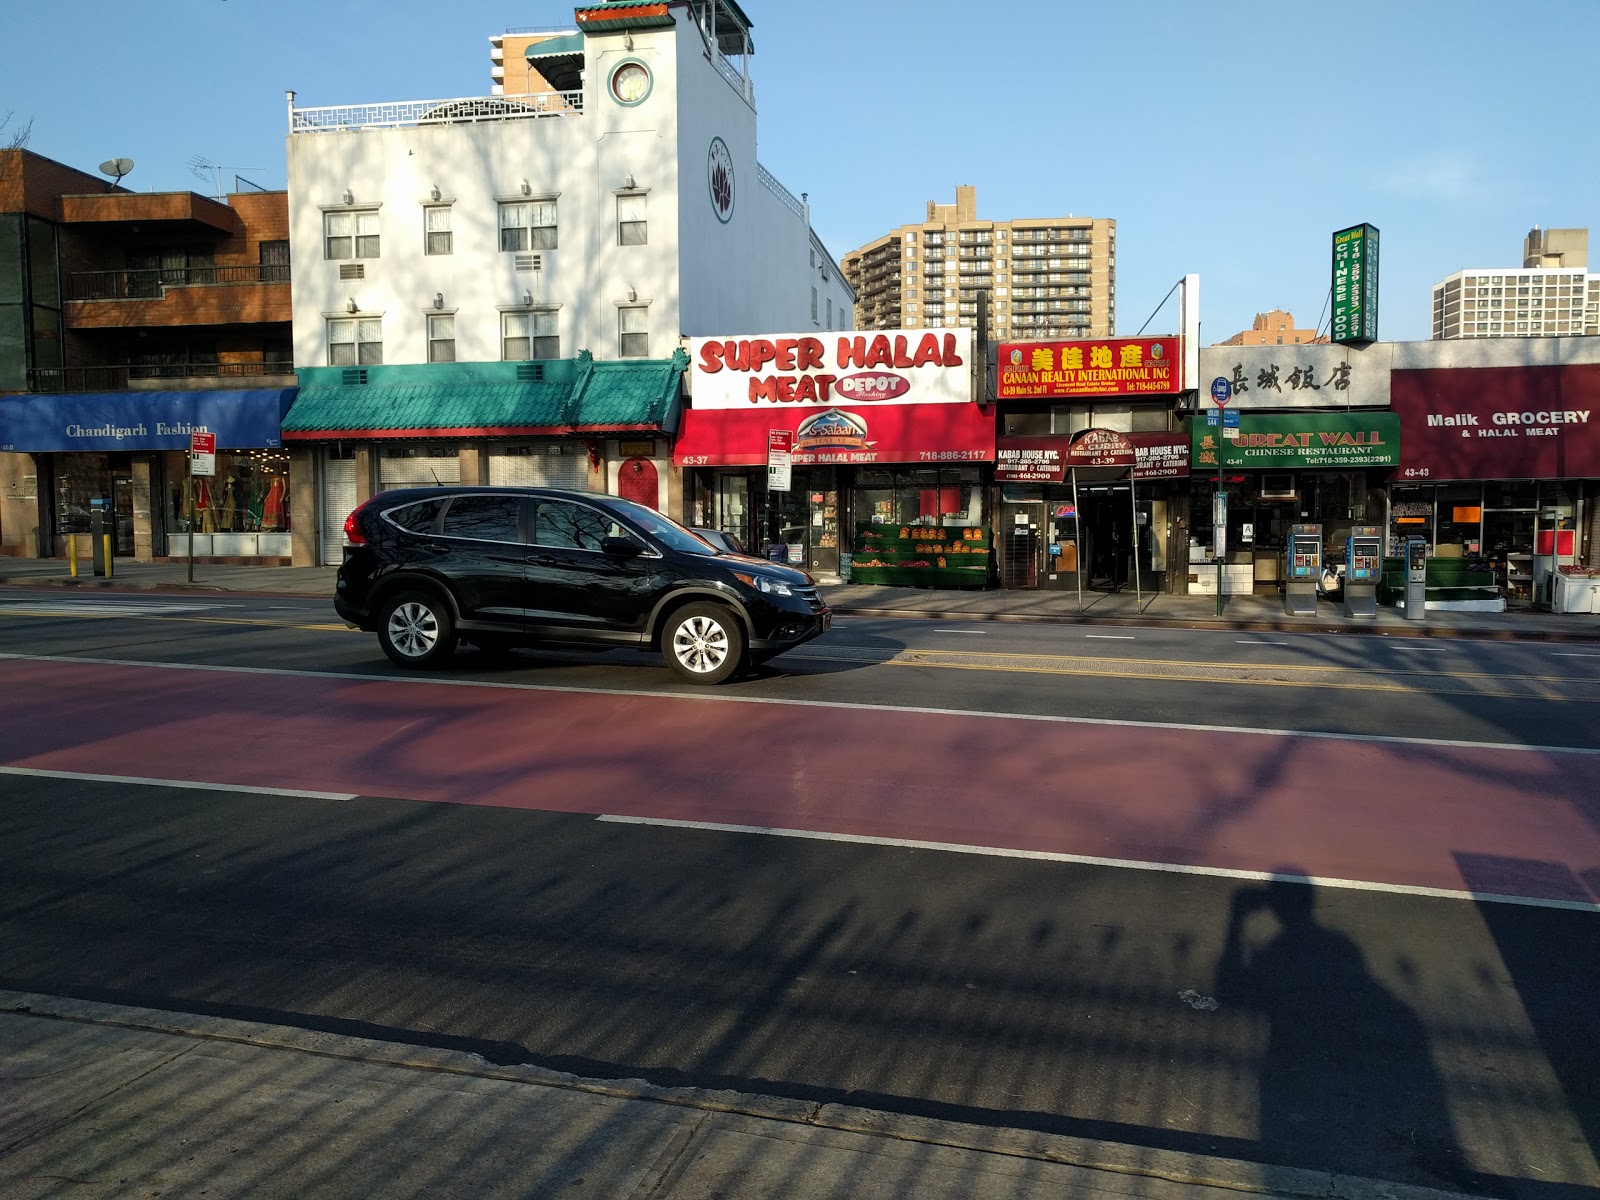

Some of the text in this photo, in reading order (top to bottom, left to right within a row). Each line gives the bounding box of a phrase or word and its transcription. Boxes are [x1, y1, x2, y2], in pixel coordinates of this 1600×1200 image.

[1334, 243, 1348, 340] CHINESE FOOD
[698, 333, 963, 373] SUPER HALAL
[1003, 367, 1170, 384] CANAAN REALTY INTERNATIONAL INC
[1230, 361, 1352, 395] 長城飯店
[749, 374, 837, 403] MEAT
[842, 376, 900, 392] DEPOT
[1427, 410, 1591, 426] Malik GROCERY
[66, 422, 208, 440] Chandigarh Fashion
[1084, 431, 1119, 444] KABAB
[1462, 427, 1559, 437] & HALAL MEAT
[1231, 431, 1385, 448] GREAT WALL
[1088, 442, 1127, 451] CURRY
[1135, 447, 1148, 457] BAB
[1150, 446, 1172, 456] HOUSE
[1245, 446, 1373, 457] CHINESE RESTAURANT
[682, 456, 708, 465] 43-37
[791, 454, 815, 462] UPER
[818, 453, 848, 462] HALAL
[850, 452, 878, 462] MEAT
[919, 450, 986, 460] 718-886-2117
[998, 450, 1020, 459] KABAB
[1022, 450, 1043, 459] HOUSE
[1405, 468, 1429, 477] 43-43
